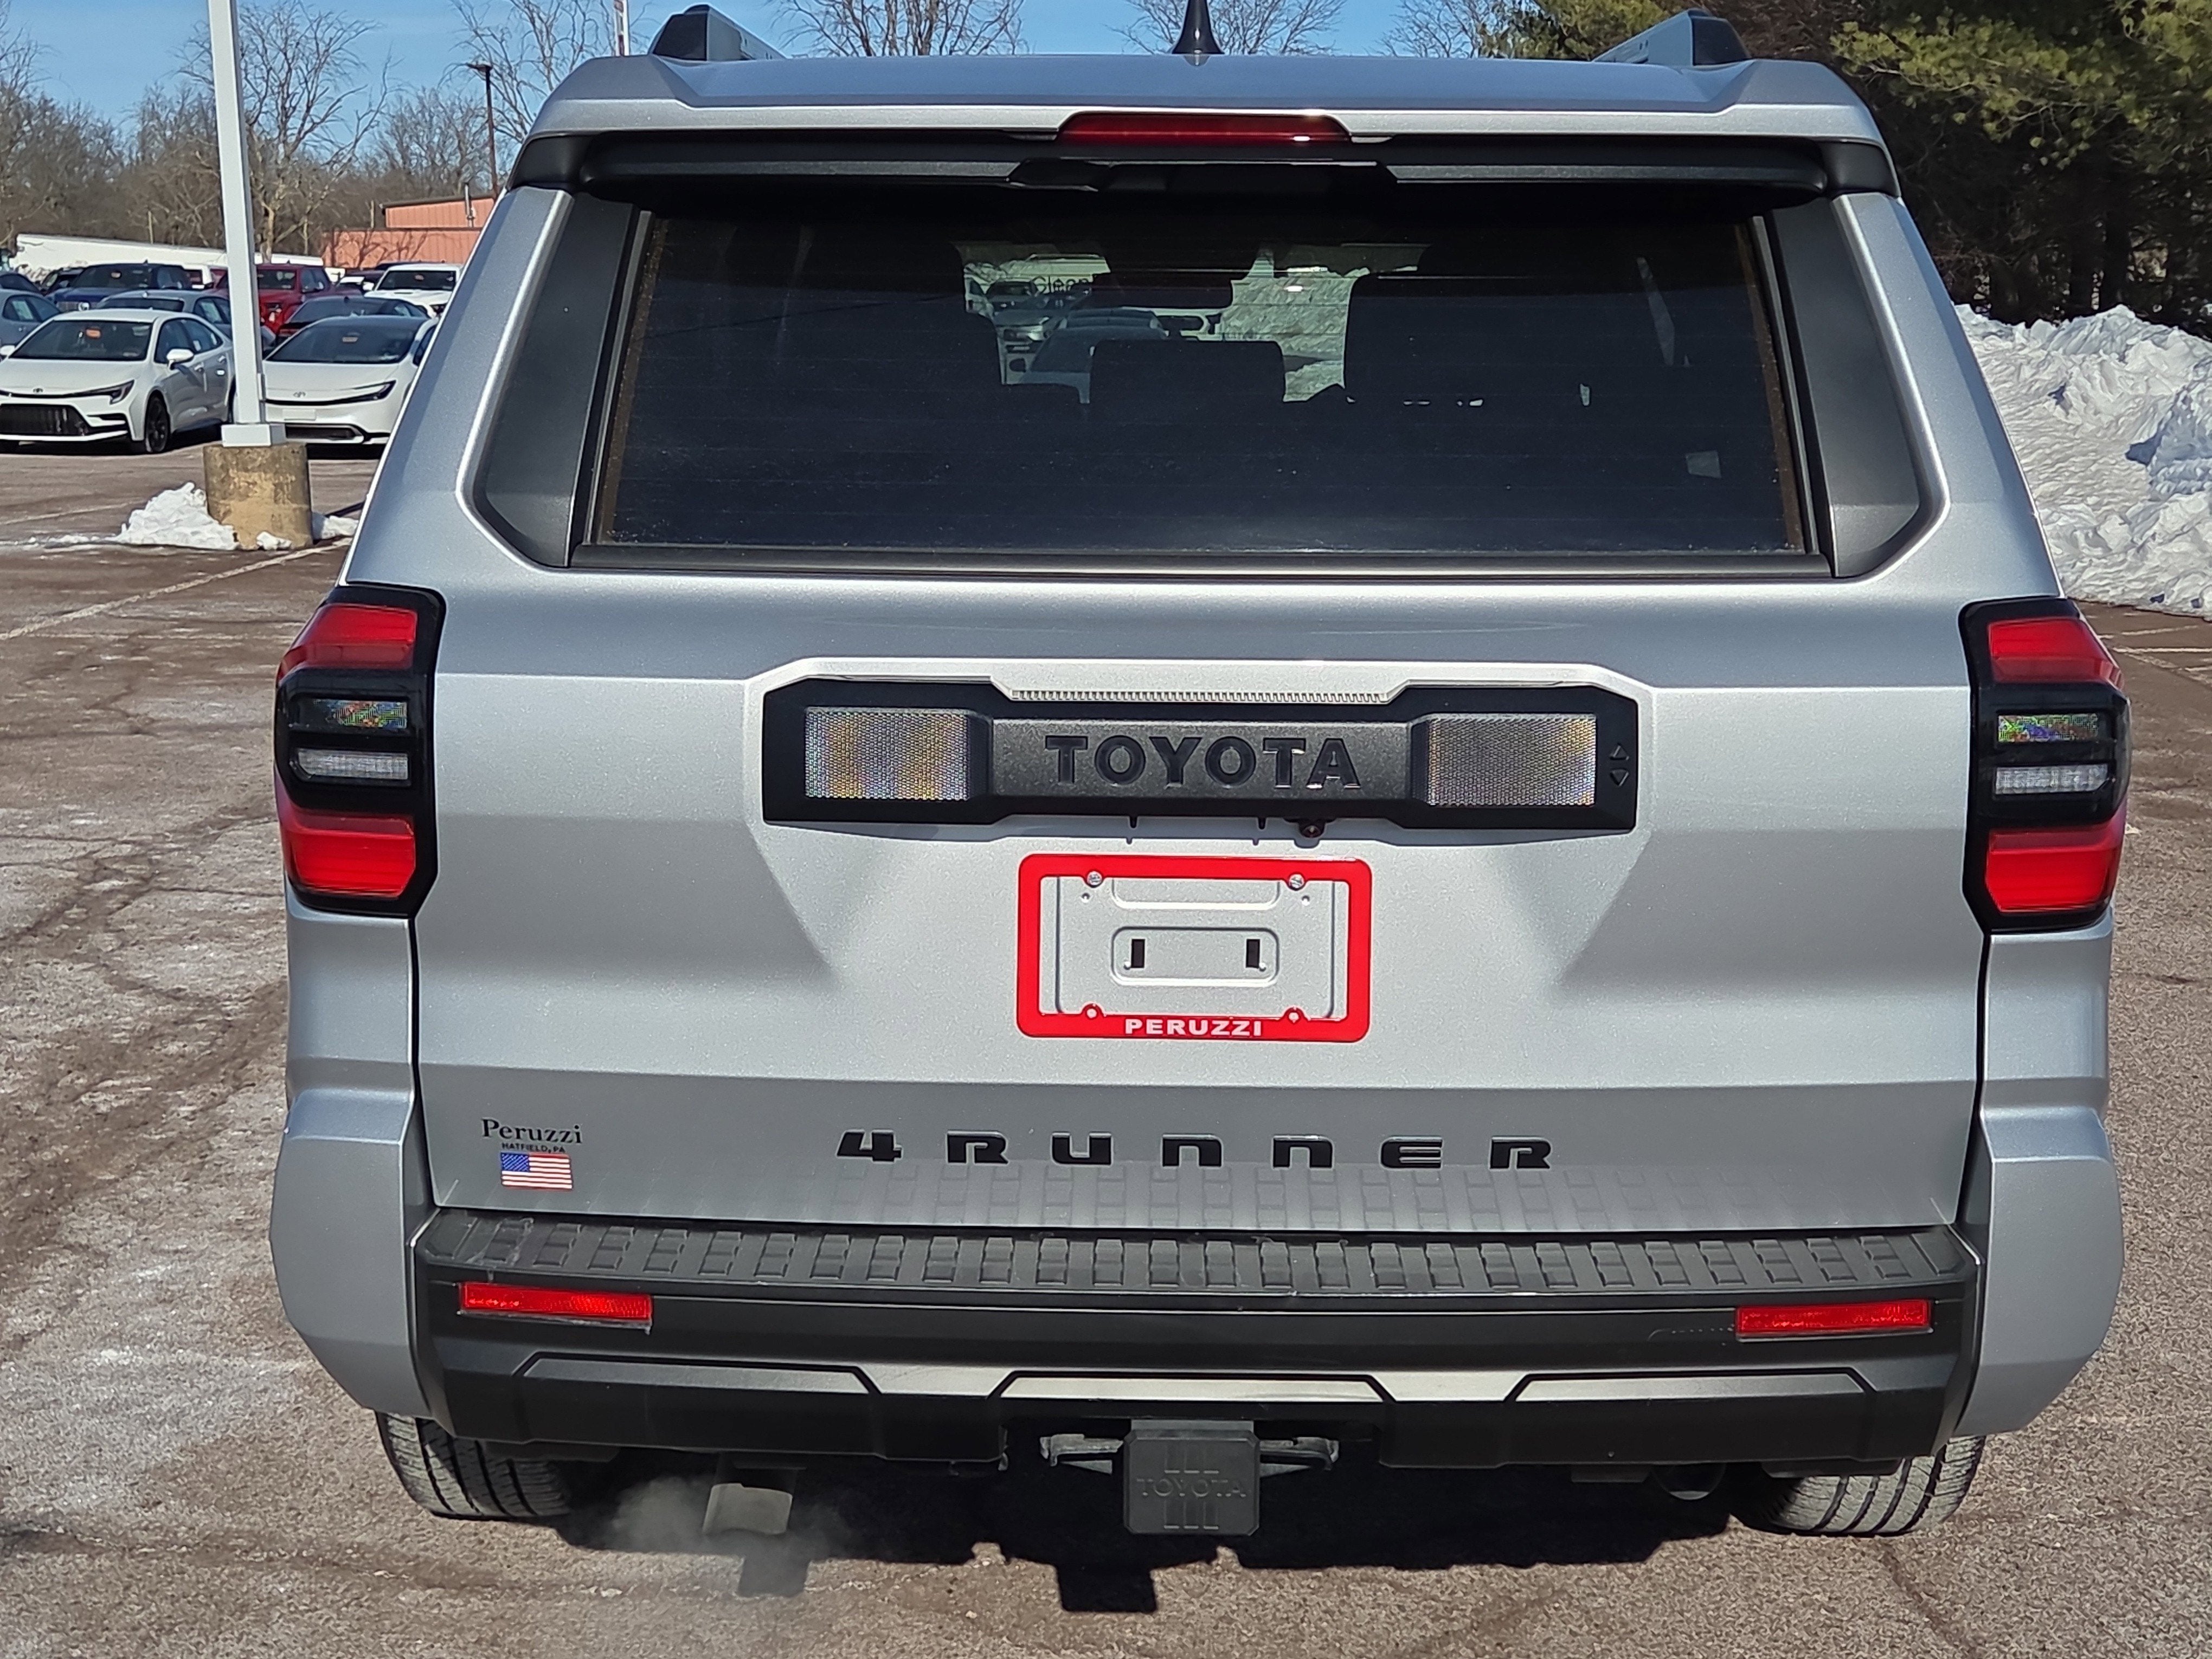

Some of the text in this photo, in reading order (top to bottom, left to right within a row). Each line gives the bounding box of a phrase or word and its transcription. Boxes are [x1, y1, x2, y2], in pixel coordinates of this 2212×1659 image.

[1045, 735, 1361, 789] TOYOTA
[1125, 1018, 1262, 1037] PERUZZI
[481, 1118, 583, 1144] Peruzzi
[836, 1130, 1553, 1170] 4RUNNER
[1136, 1477, 1246, 1497] TOYOTA
